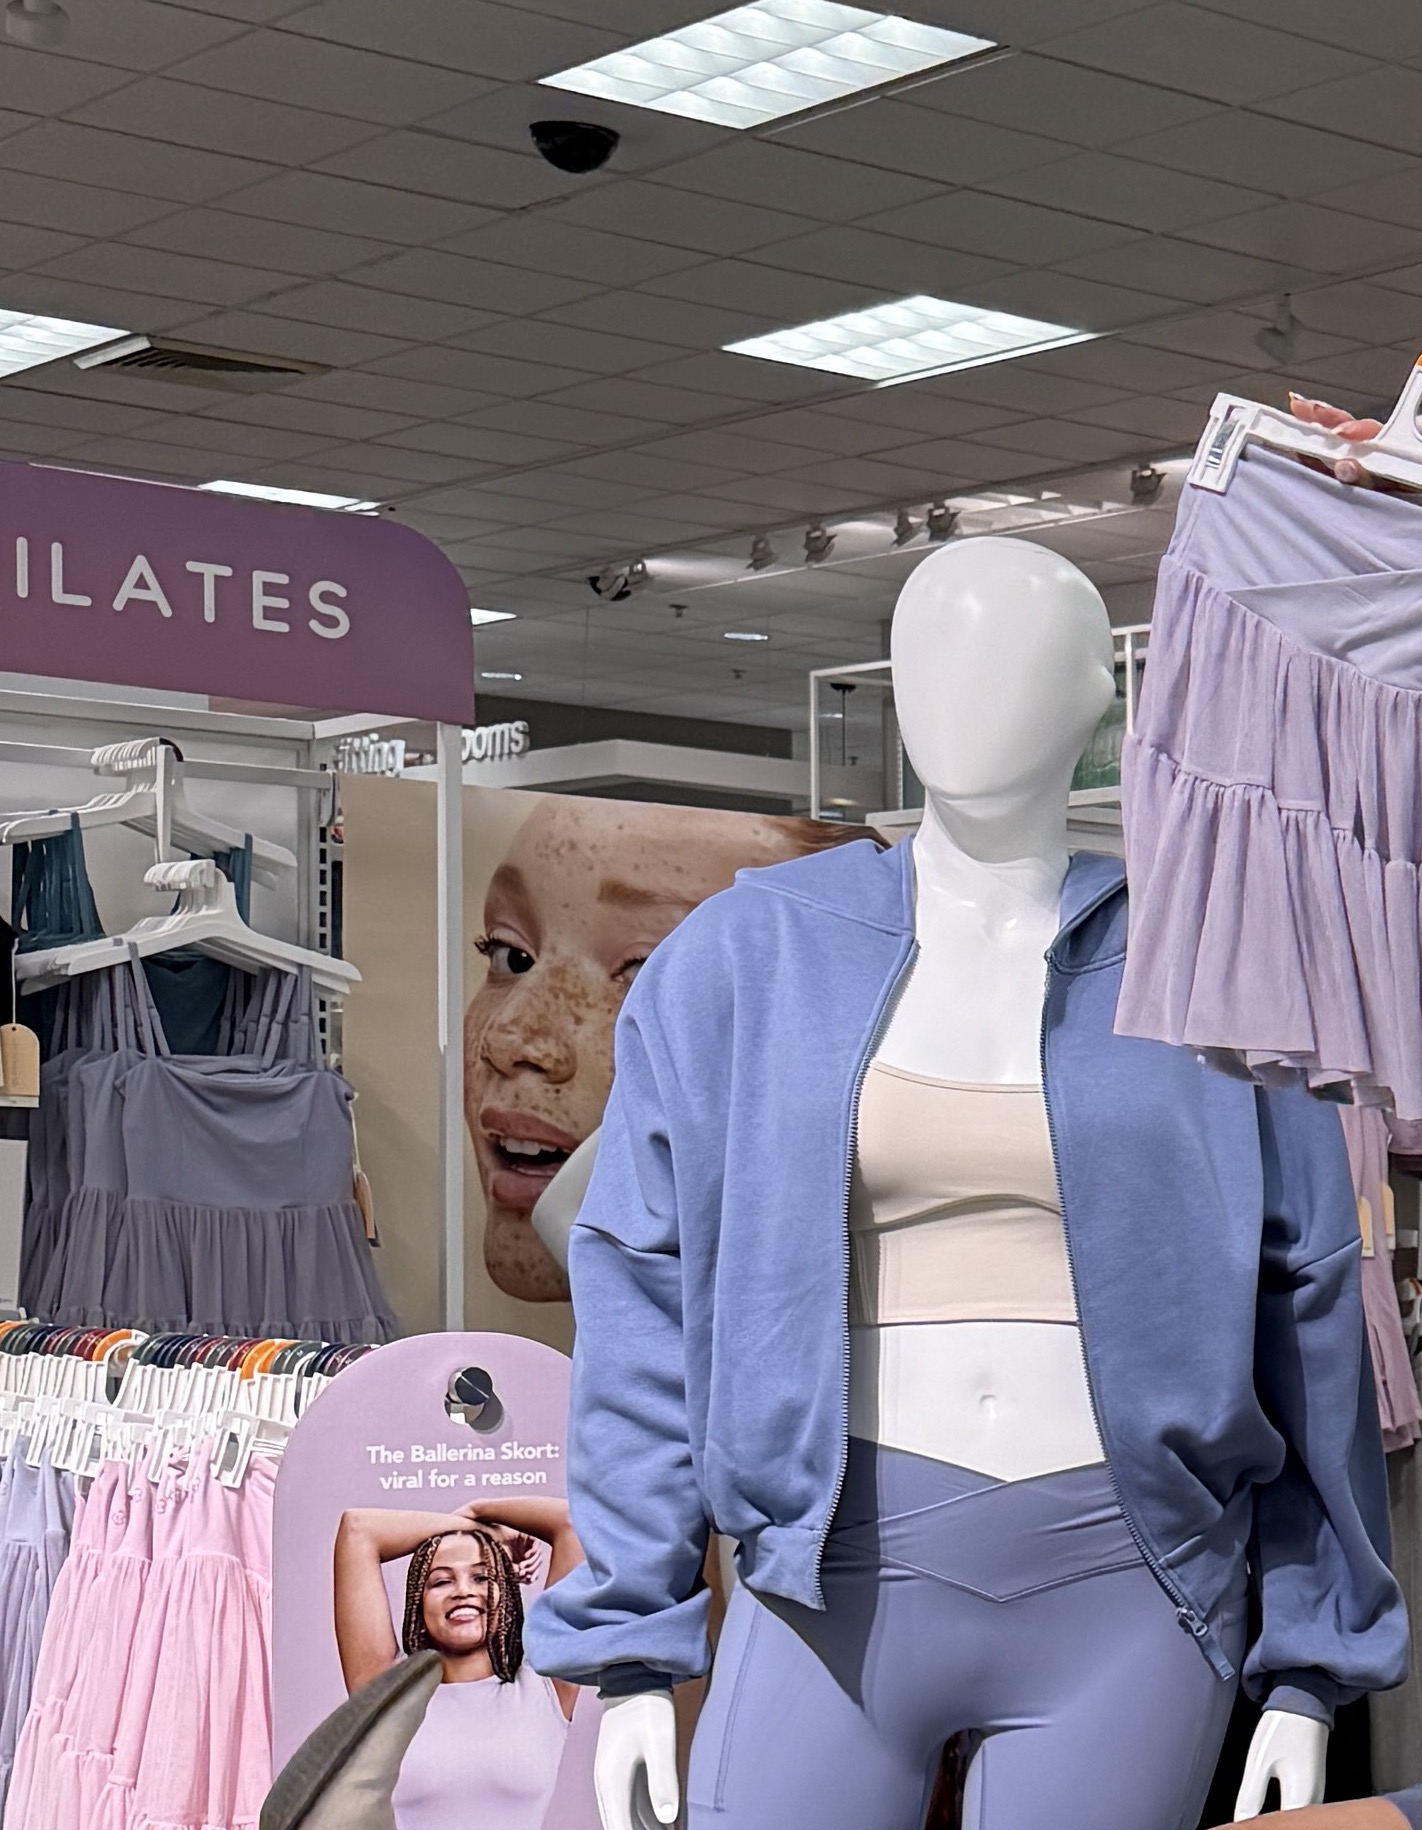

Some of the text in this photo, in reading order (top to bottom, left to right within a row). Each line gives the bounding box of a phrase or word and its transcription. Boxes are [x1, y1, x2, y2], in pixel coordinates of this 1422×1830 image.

[16, 536, 351, 640] ILATES
[366, 1441, 560, 1464] The Ballerina Skort:
[380, 1468, 547, 1490] viral for a reason
